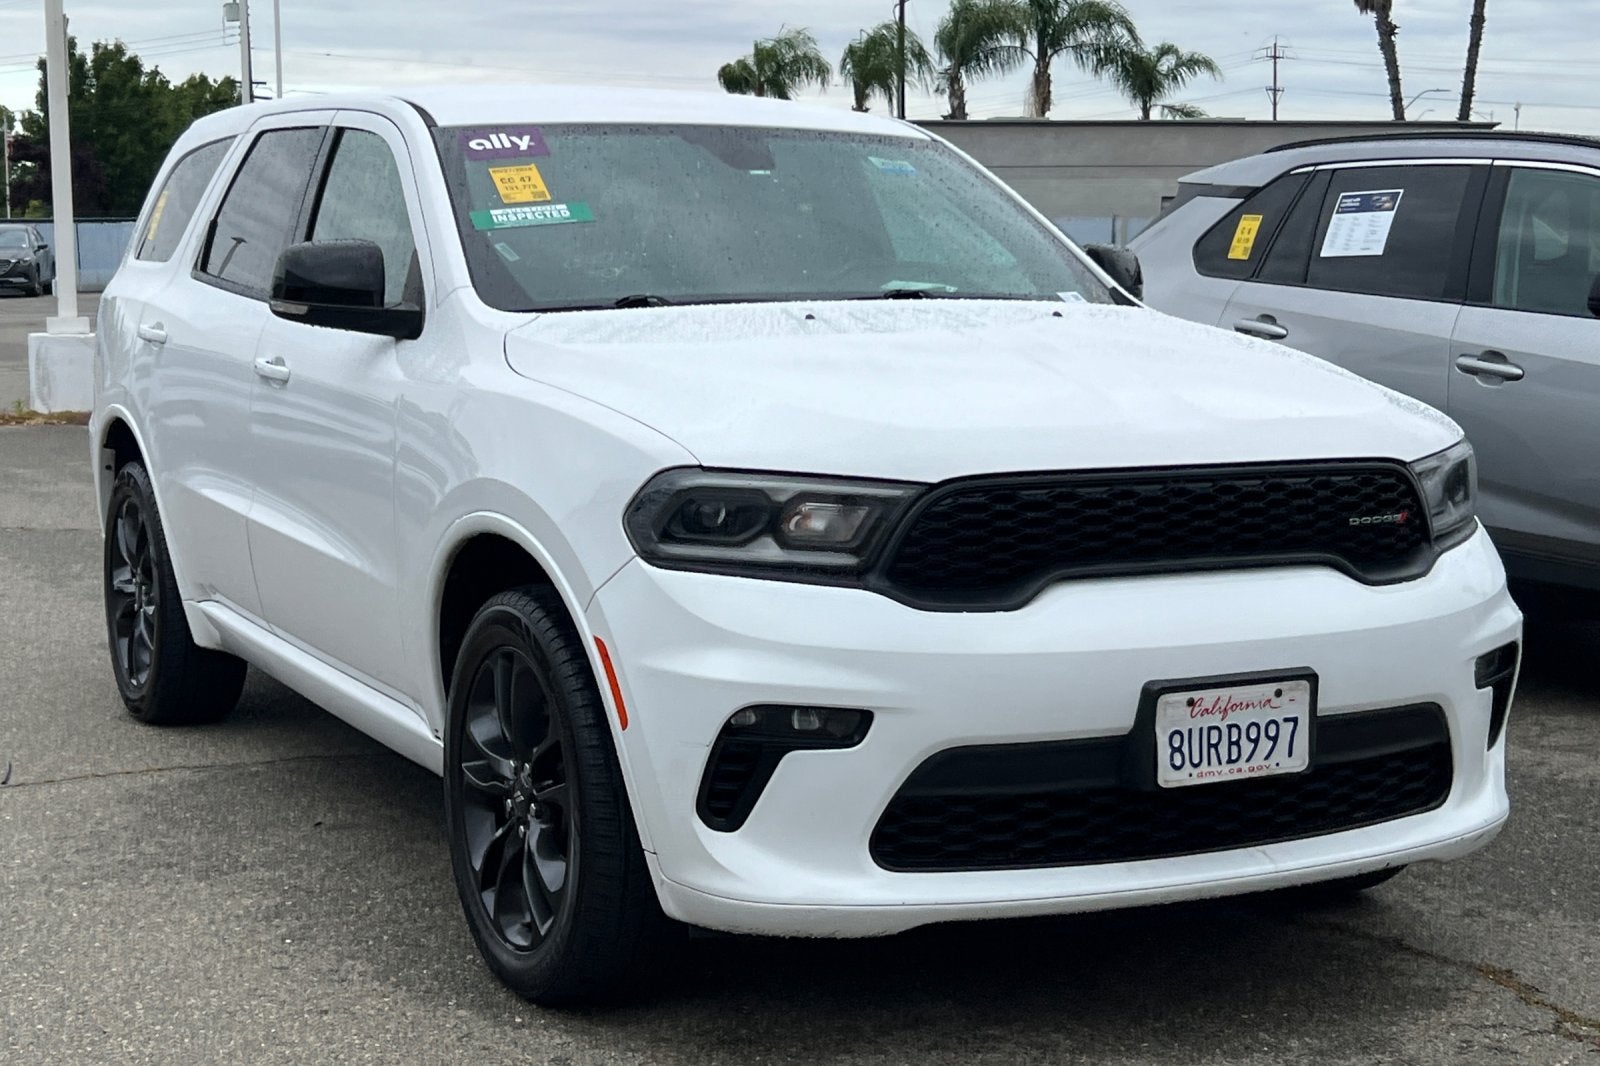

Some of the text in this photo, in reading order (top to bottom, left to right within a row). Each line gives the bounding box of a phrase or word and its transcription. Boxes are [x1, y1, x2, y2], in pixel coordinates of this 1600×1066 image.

[468, 132, 531, 151] ally
[492, 209, 571, 224] INSPECTED
[1349, 513, 1401, 526] DODGE
[1189, 694, 1282, 721] California
[1168, 715, 1299, 771] 8URB997
[1196, 763, 1272, 779] dmv.ca.gov
